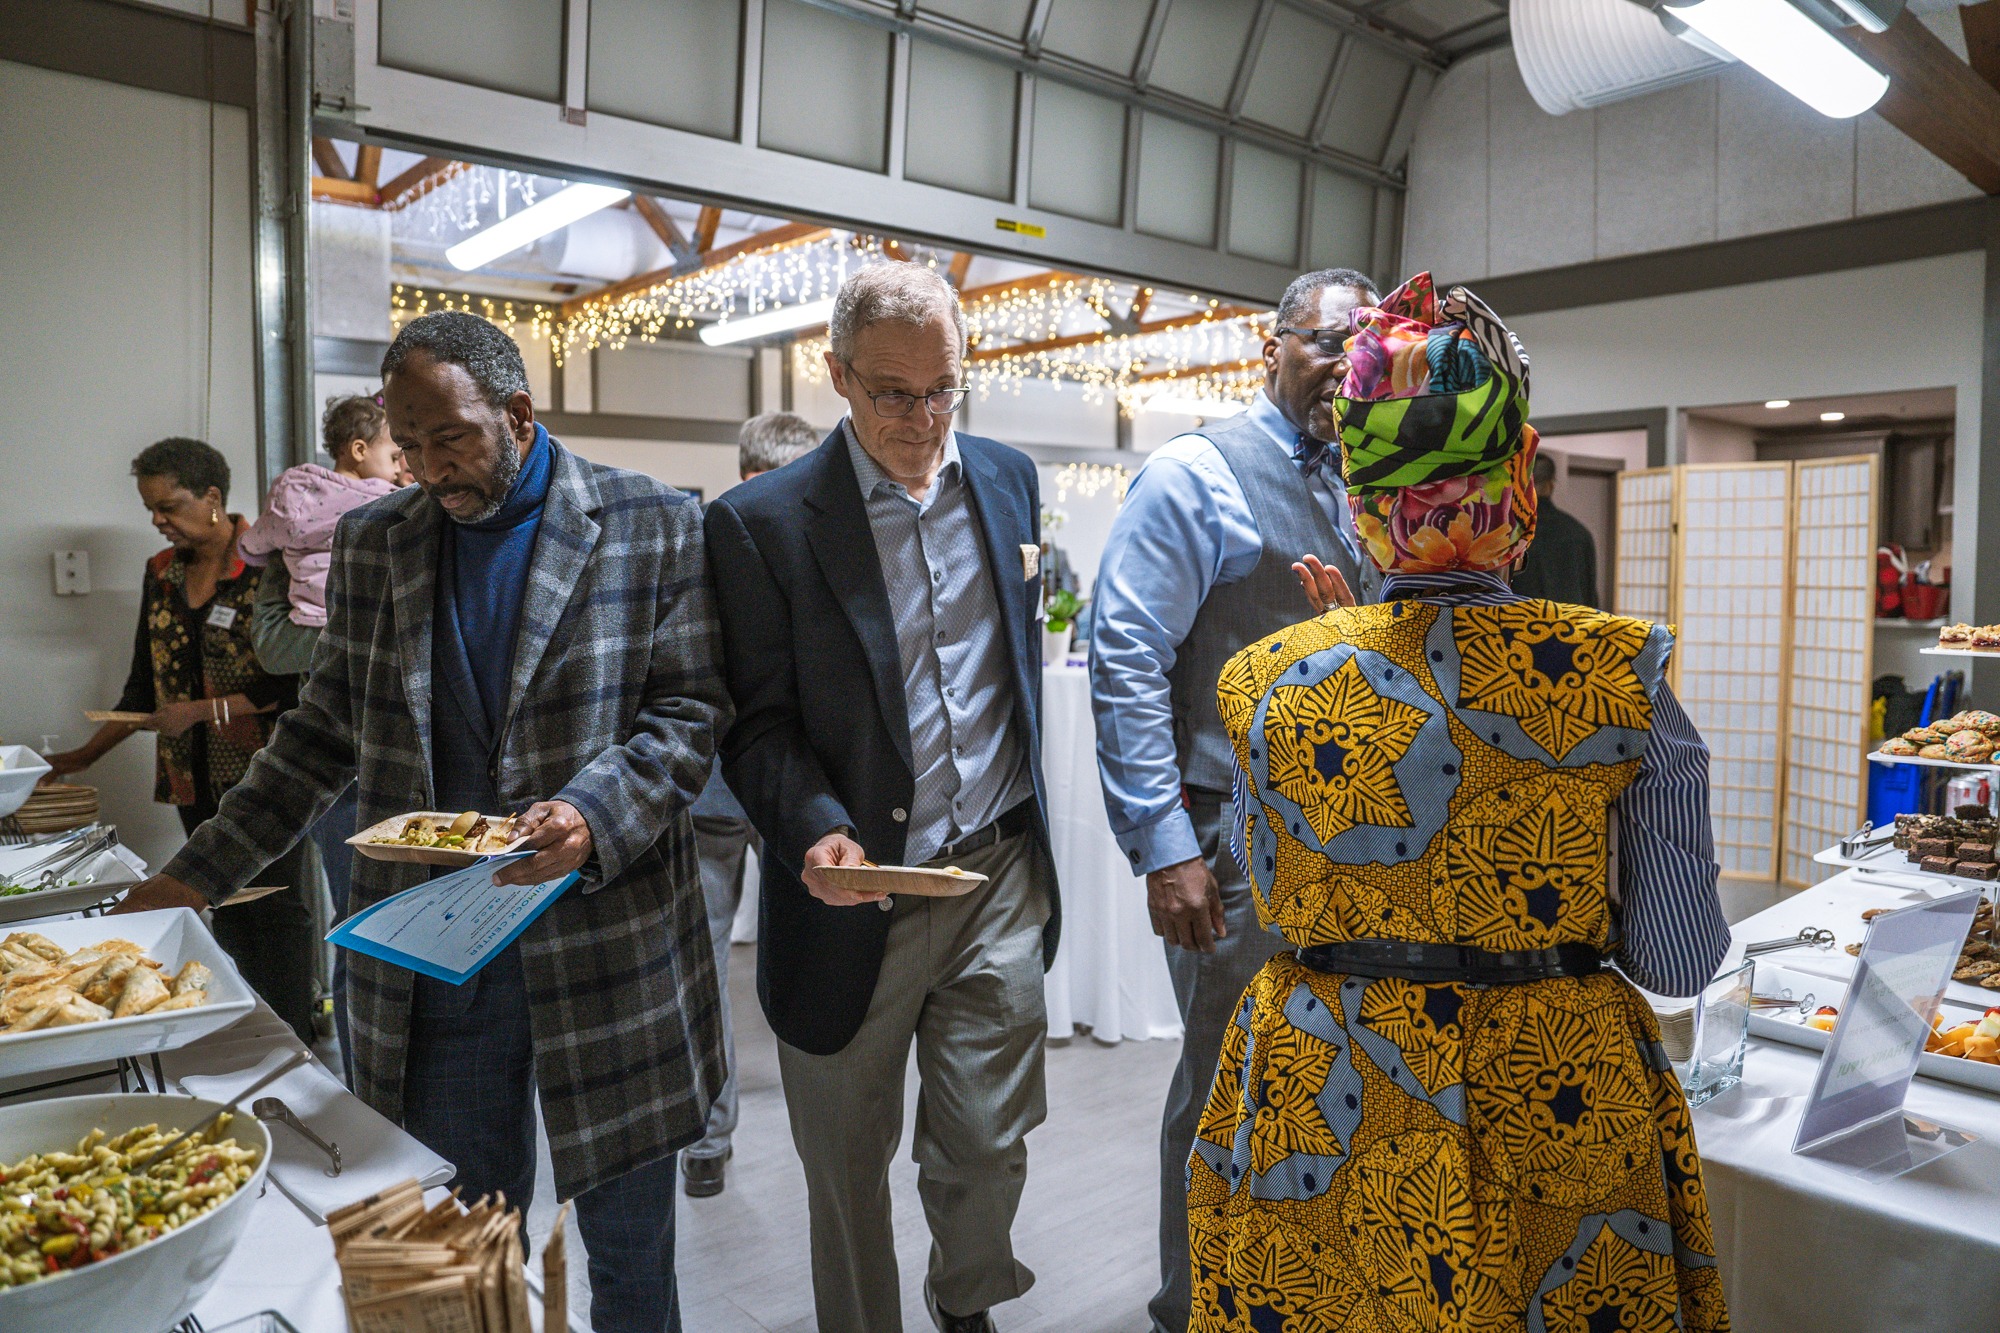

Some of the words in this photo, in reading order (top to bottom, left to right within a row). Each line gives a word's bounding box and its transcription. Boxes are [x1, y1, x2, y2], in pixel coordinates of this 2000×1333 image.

[508, 883, 546, 920] DIMOCK
[386, 927, 404, 944] Brigham
[402, 914, 418, 930] General
[469, 920, 508, 957] CENTER
